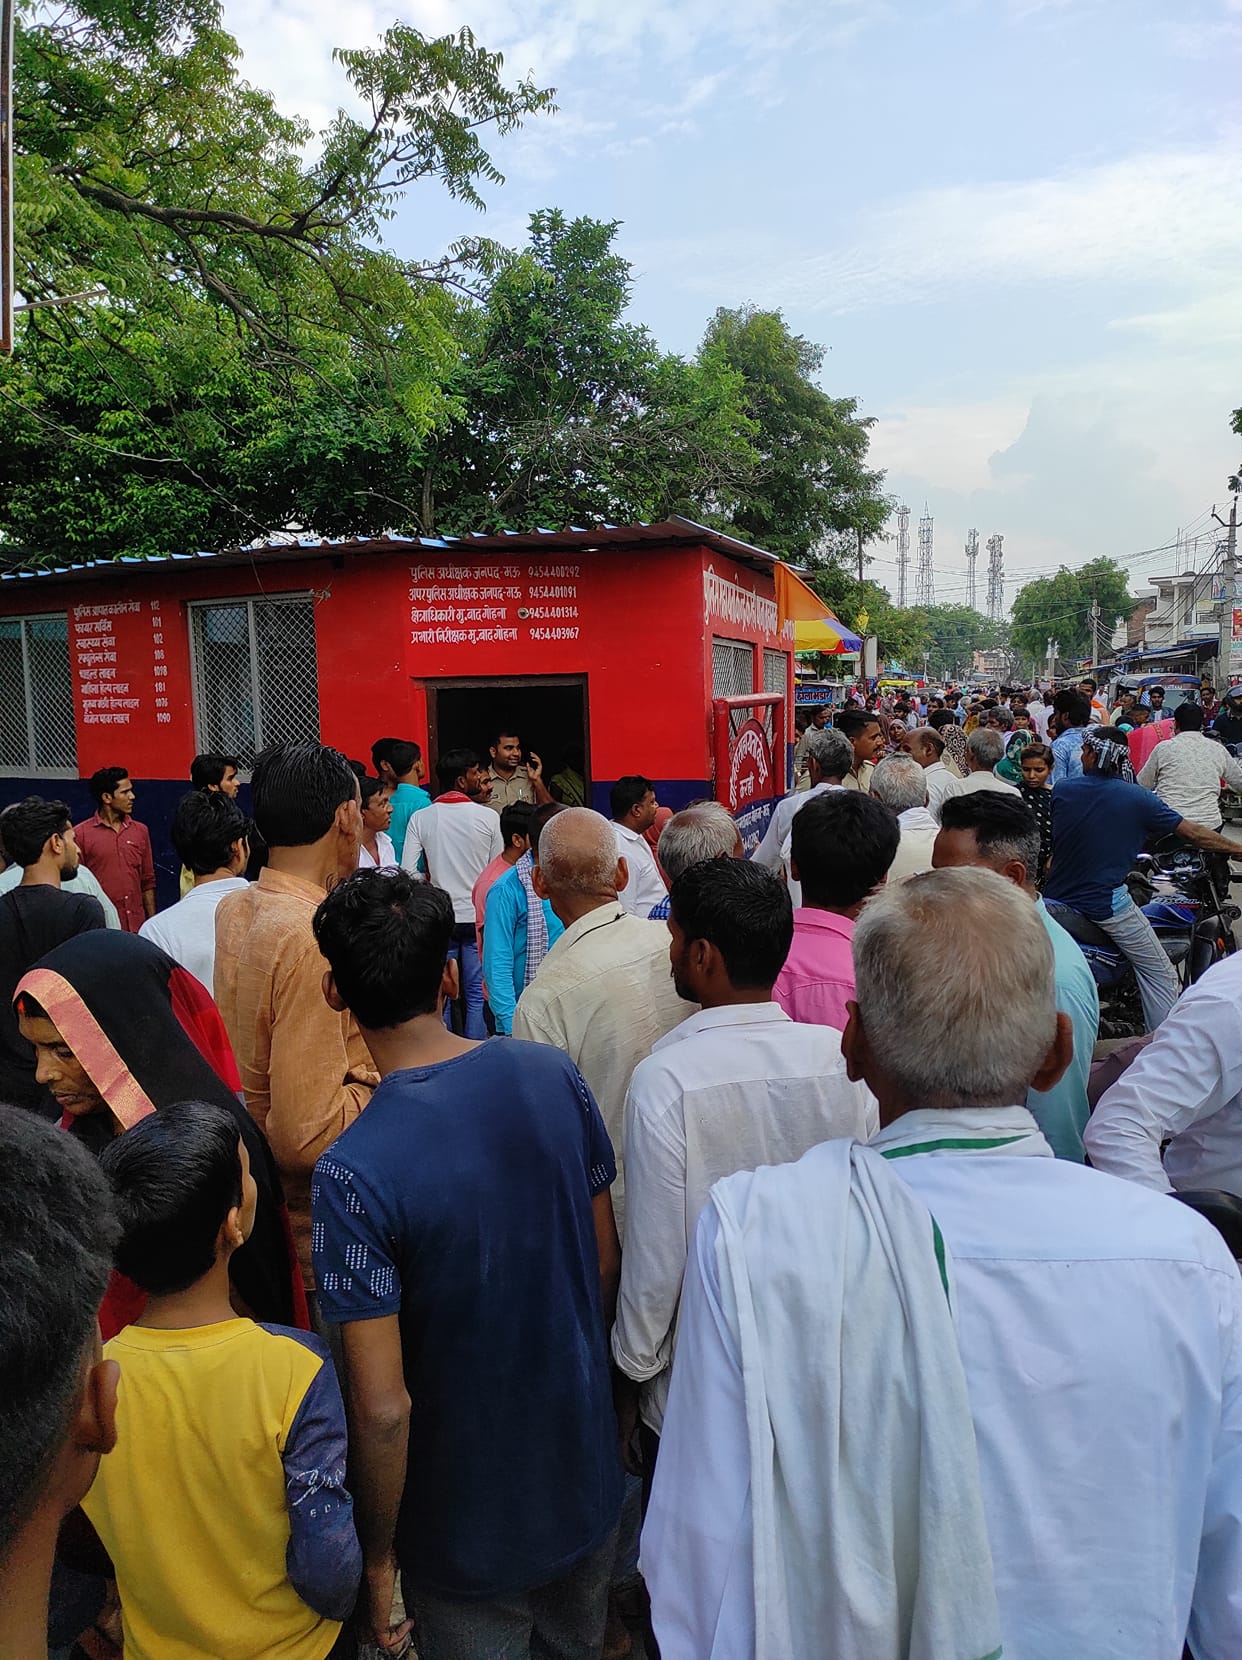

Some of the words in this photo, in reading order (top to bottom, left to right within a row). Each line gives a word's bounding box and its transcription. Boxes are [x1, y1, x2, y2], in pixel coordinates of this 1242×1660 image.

[409, 564, 435, 583] पुलिस
[436, 563, 472, 580] अधीक्षक
[425, 584, 447, 603] पुलिस
[447, 583, 478, 602] अधीक्षक
[411, 605, 455, 624] क्षेत्राधिकारी
[411, 627, 435, 644] प्रभारी
[435, 626, 468, 644] निरीक्षक
[154, 681, 166, 693] 181
[156, 712, 171, 723] 1090
